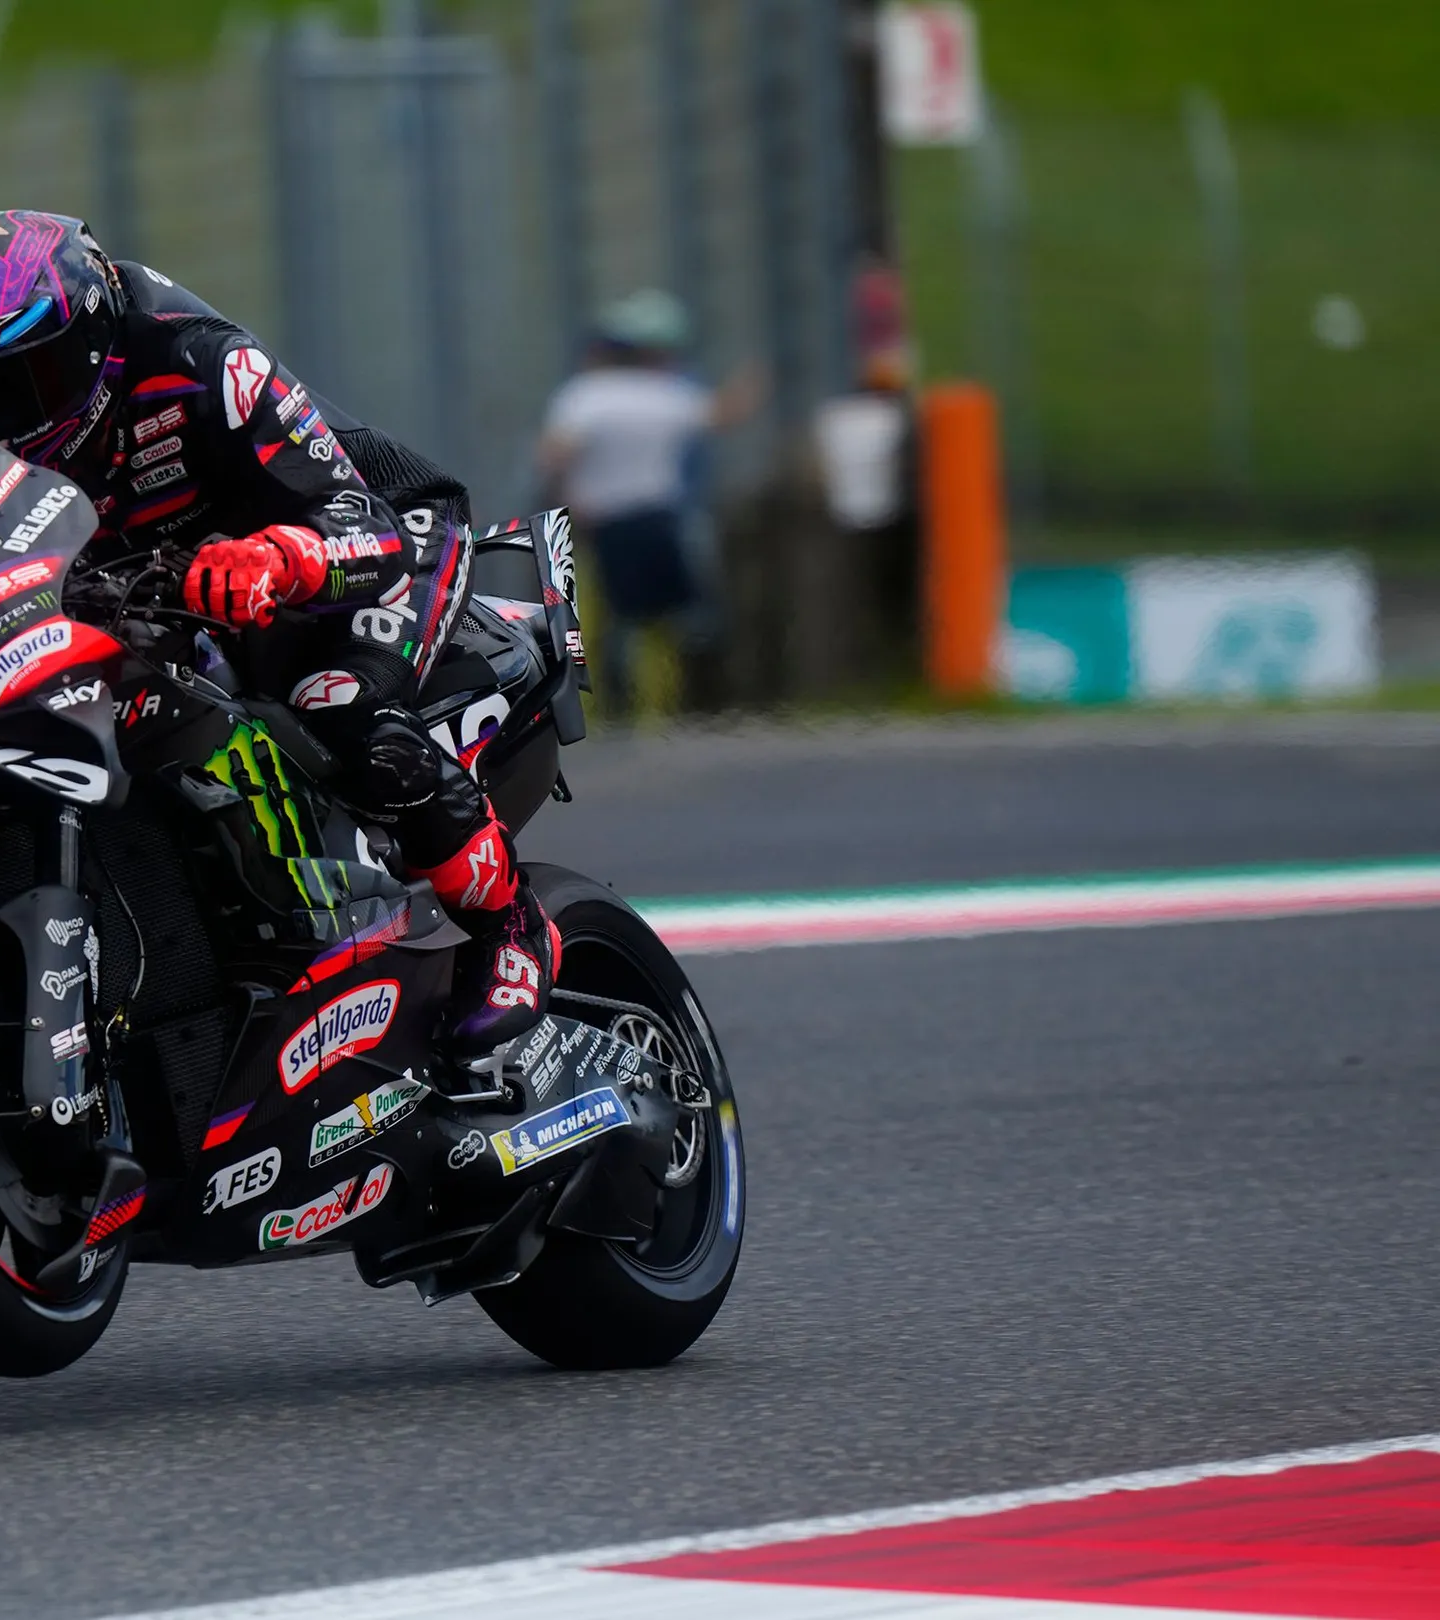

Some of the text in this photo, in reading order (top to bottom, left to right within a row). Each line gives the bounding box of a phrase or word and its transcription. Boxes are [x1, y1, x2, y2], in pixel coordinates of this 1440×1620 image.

[37, 420, 54, 434] Right
[143, 438, 180, 462] Castrol
[136, 465, 181, 490] DELLORTO
[2, 485, 79, 554] DELLORTO
[323, 525, 384, 567] aprilia
[346, 571, 379, 583] MONSTER
[9, 660, 42, 691] alimenti
[48, 679, 103, 711] sky
[61, 965, 80, 982] PAN
[50, 1021, 87, 1053] SC
[289, 986, 392, 1075] sterilgarda
[515, 1016, 558, 1067] YASHI
[530, 1043, 561, 1094] SC
[315, 1083, 424, 1149] Green Power
[537, 1100, 617, 1145] MICHELIN
[227, 1155, 275, 1201] FES
[295, 1167, 389, 1240] Castrol
